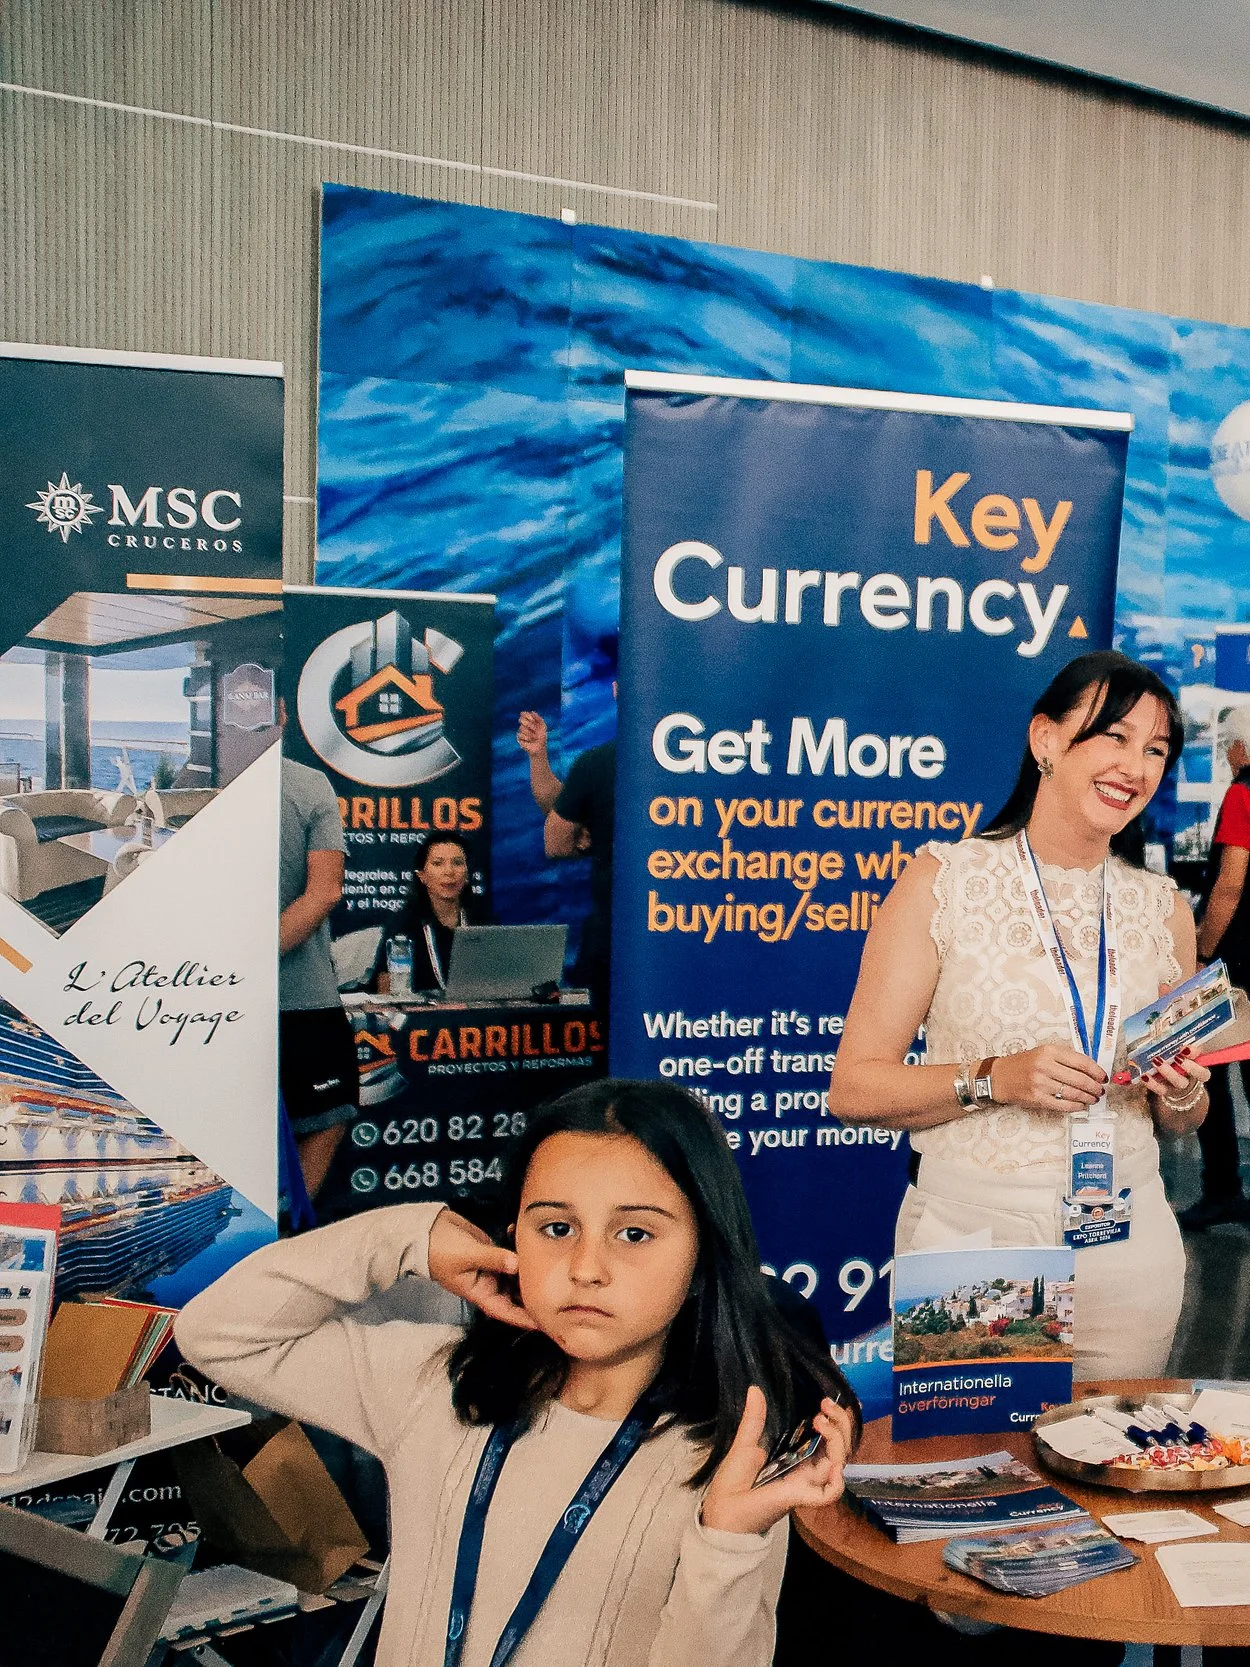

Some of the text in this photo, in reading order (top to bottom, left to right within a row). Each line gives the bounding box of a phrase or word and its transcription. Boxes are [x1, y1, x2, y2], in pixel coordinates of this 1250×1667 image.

[107, 484, 243, 533] MSC
[914, 469, 1073, 573] Key
[107, 533, 243, 553] CRUCEROS
[652, 712, 946, 779] Get More
[337, 797, 484, 830] RRILLOS
[649, 796, 984, 839] on your currency
[648, 838, 914, 890] exchange wh
[380, 884, 395, 895] en
[648, 890, 881, 944] buying/selli
[63, 996, 245, 1046] del Voyage
[643, 1010, 764, 1039] Whether
[771, 1010, 810, 1036] it's
[409, 1020, 605, 1063] CARRILLOS
[428, 1061, 507, 1076] PROYECTOS
[522, 1056, 593, 1070] REFORMAS
[659, 1047, 765, 1077] one-off
[770, 1049, 836, 1074] trans
[750, 1093, 767, 1111] a
[776, 1092, 829, 1118] prop
[383, 1111, 528, 1147] 620 82 28
[749, 1127, 808, 1156] your
[816, 1126, 902, 1151] money
[1095, 1130, 1111, 1143] Key
[1072, 1139, 1111, 1150] Currency
[384, 1157, 502, 1191] 668 584
[830, 1340, 894, 1366] urre
[900, 1374, 1012, 1397] Internationella
[898, 1394, 997, 1414] överföringar
[871, 1499, 997, 1510] Internationella
[1009, 1505, 1065, 1517] Currency
